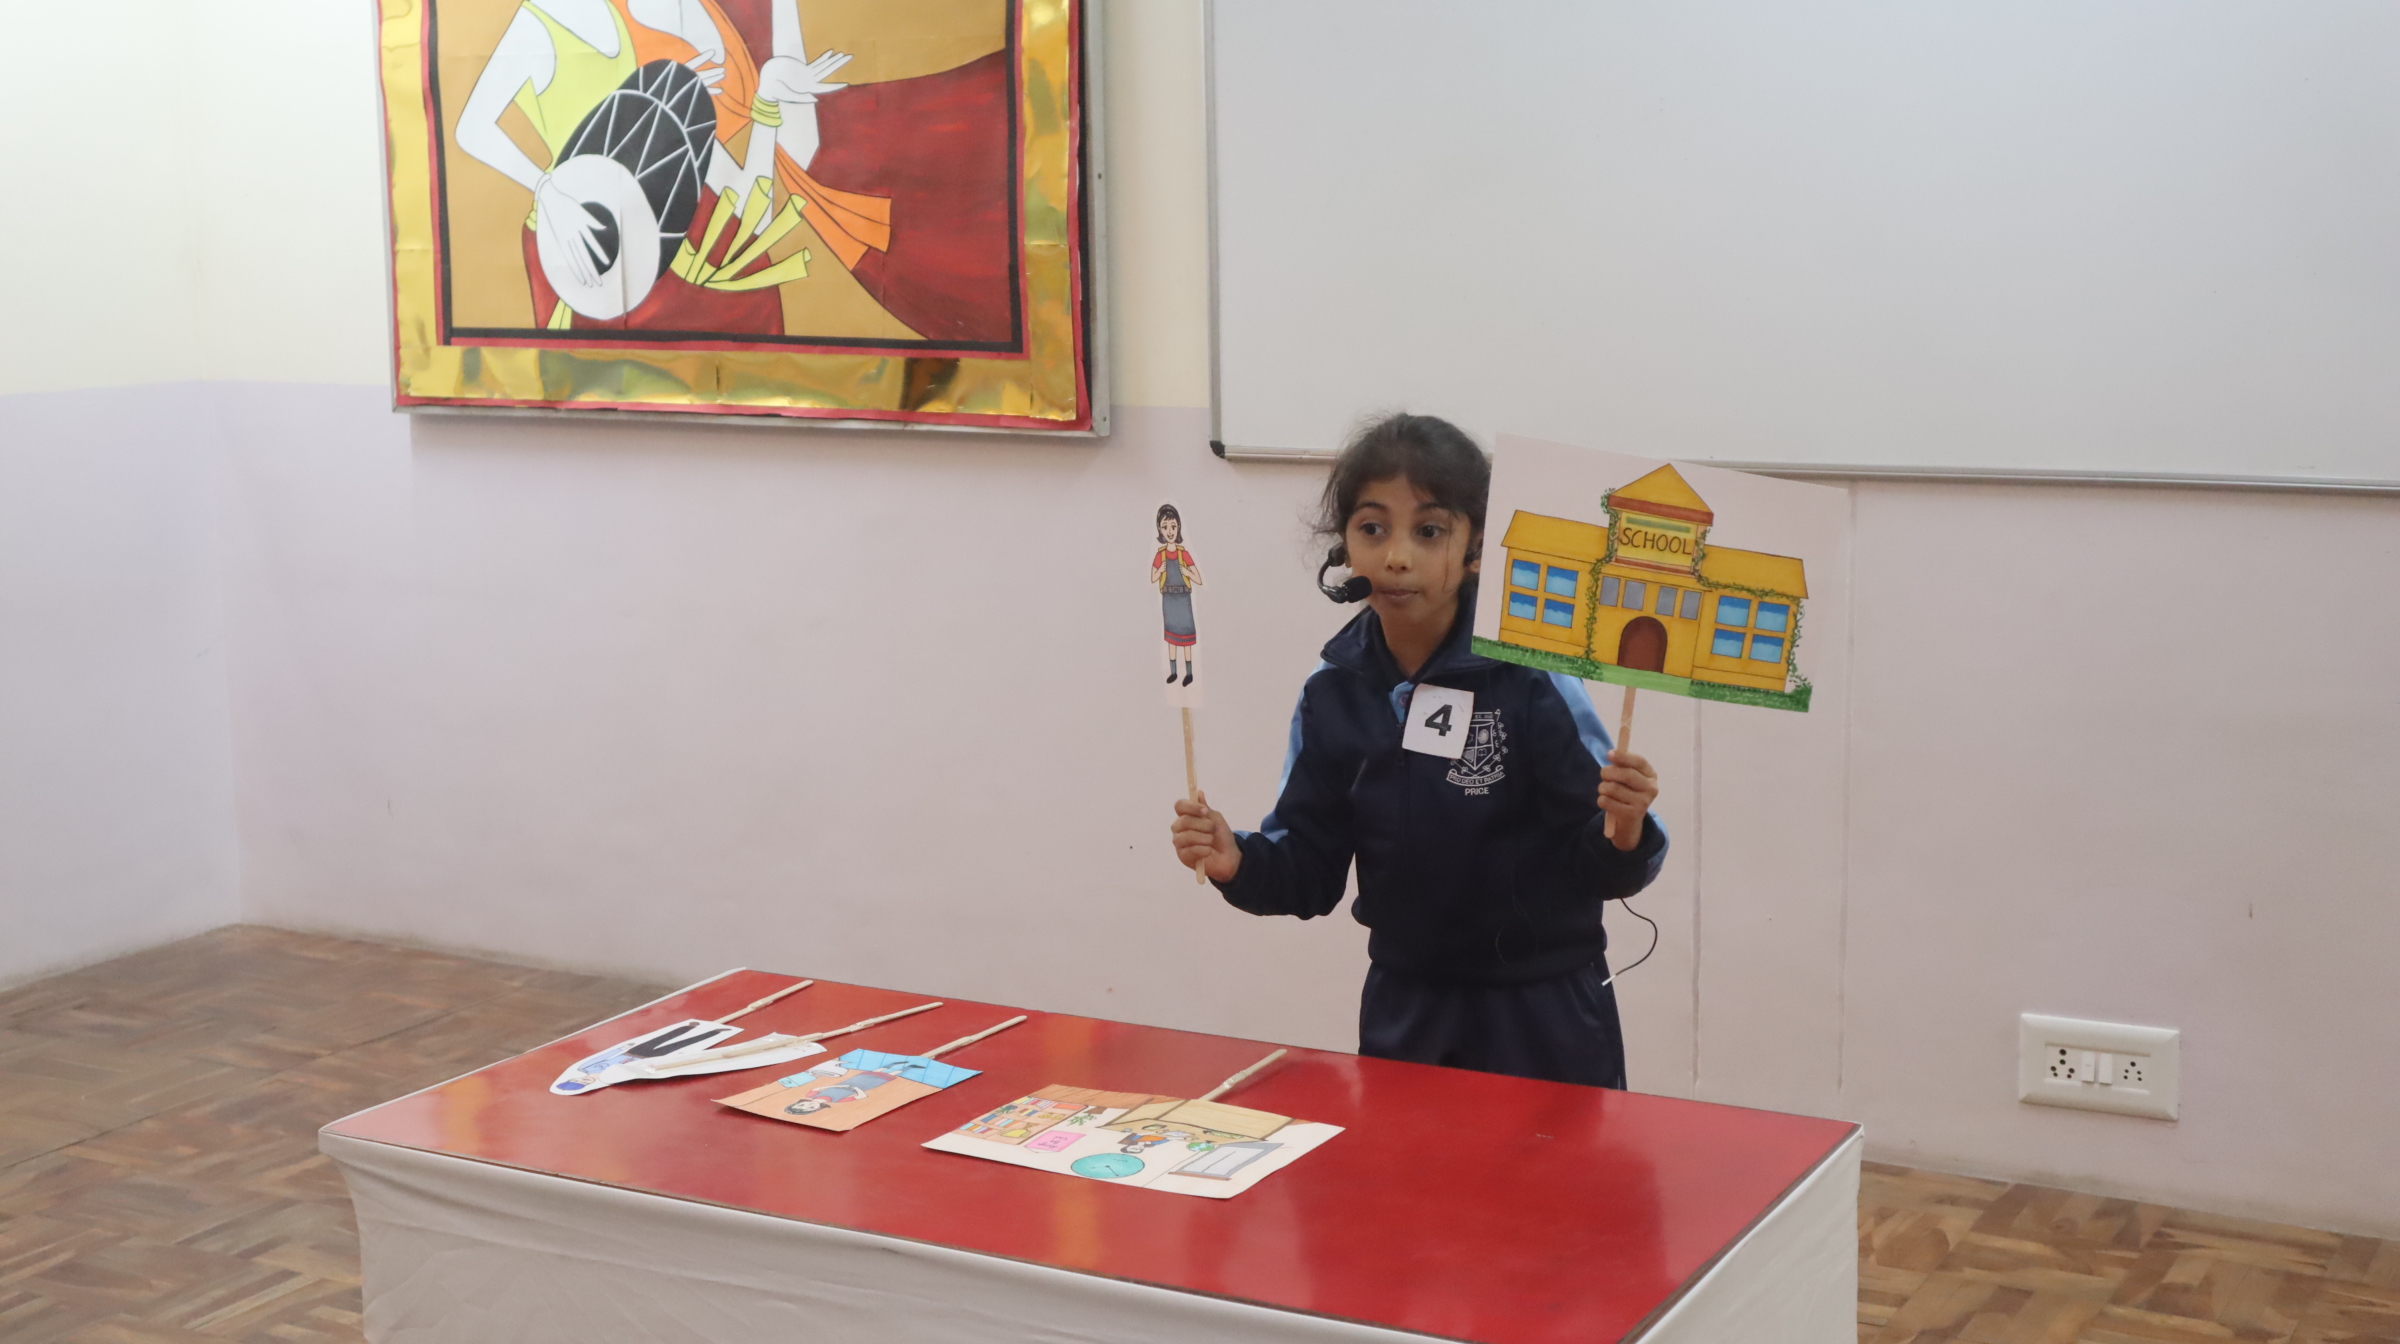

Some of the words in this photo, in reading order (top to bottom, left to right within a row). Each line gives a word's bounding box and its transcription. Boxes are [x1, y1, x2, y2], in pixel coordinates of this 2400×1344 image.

[1619, 527, 1692, 555] SCHOOL
[1425, 704, 1452, 737] 4
[1449, 774, 1461, 783] PRO
[1464, 787, 1490, 796] PRICE
